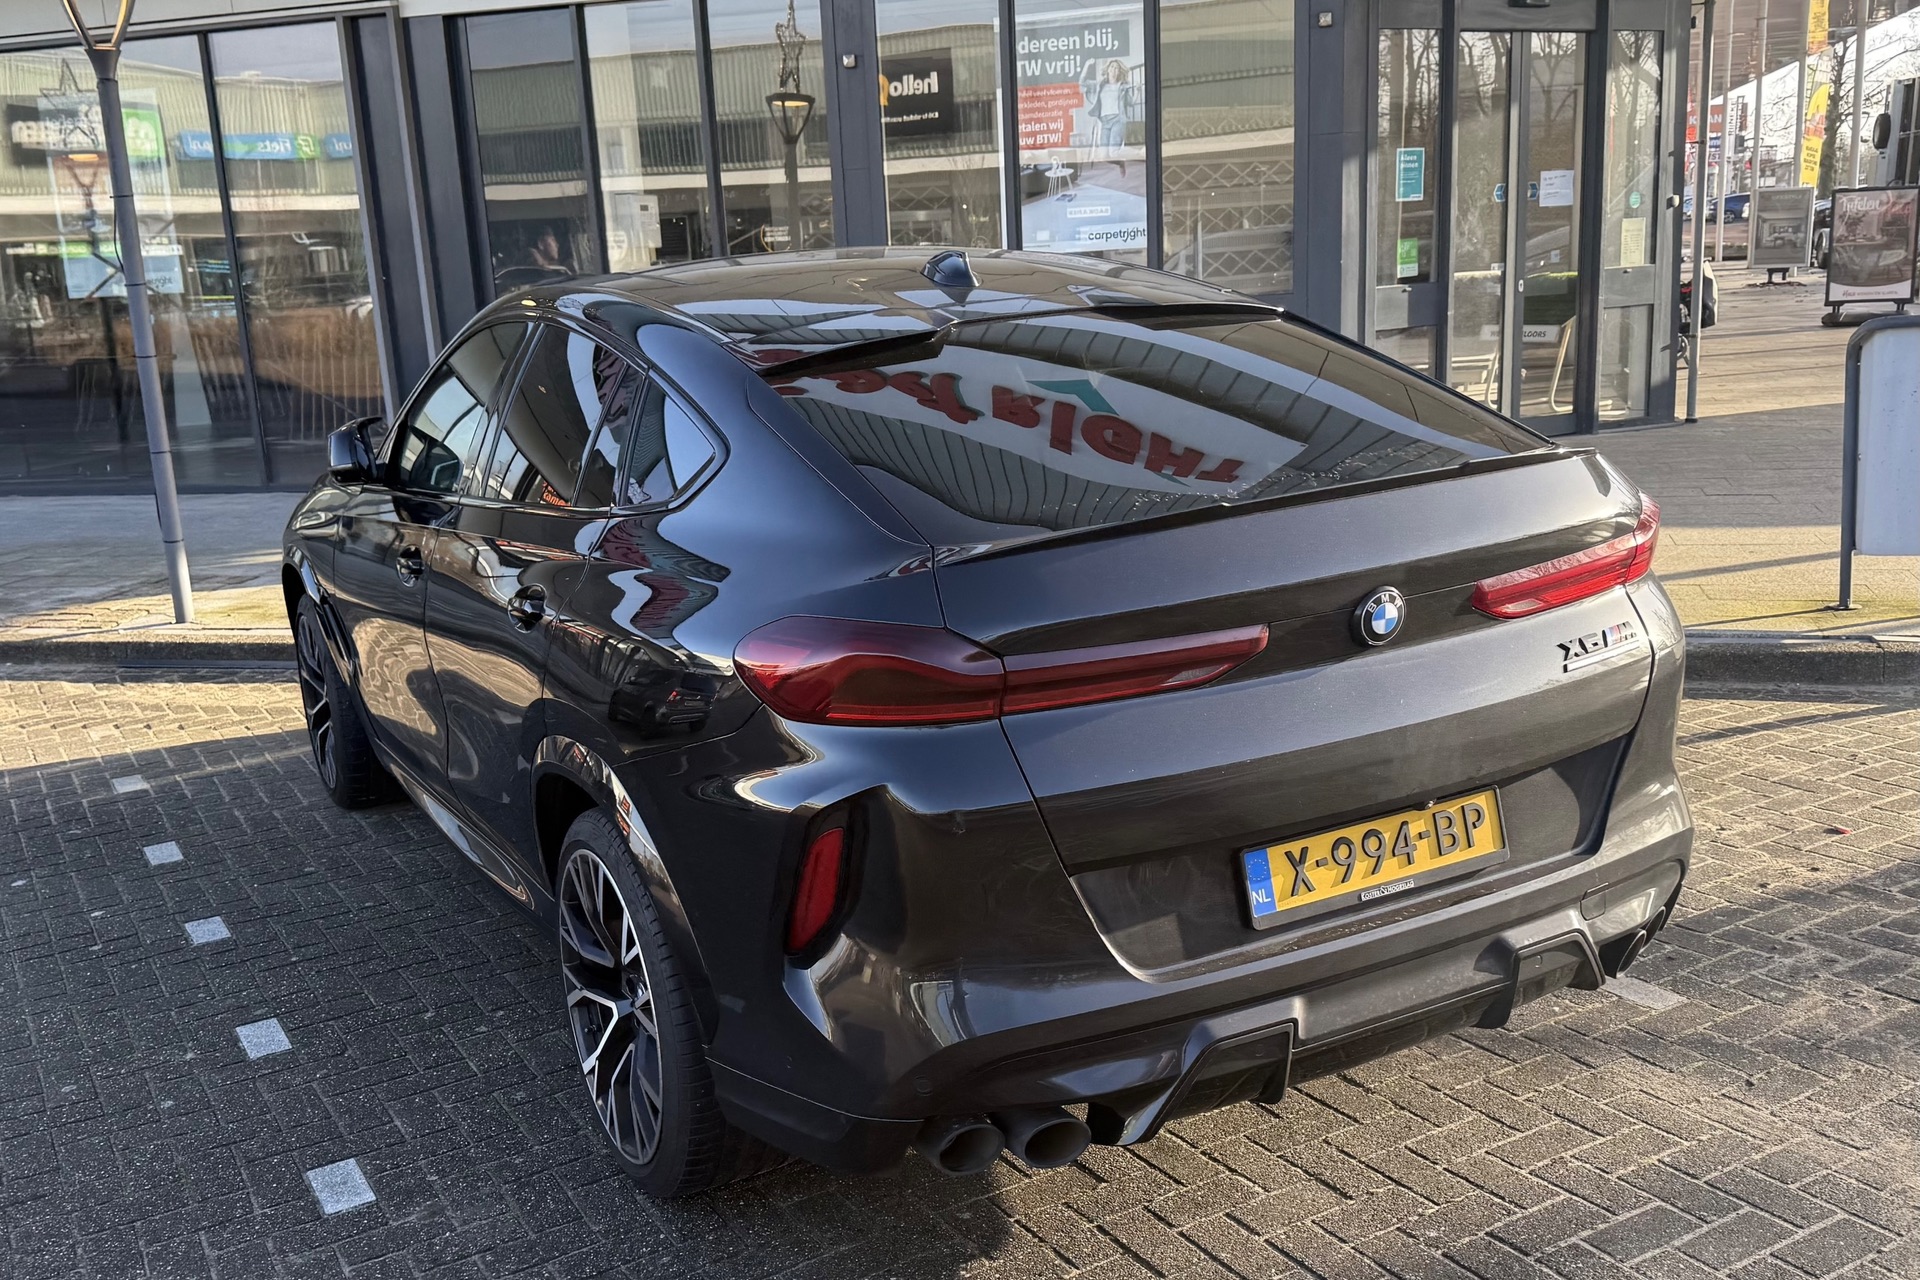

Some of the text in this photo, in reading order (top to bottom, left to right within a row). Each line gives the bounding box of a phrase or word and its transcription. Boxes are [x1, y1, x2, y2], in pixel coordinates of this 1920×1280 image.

[1084, 28, 1119, 51] blij,
[1045, 55, 1081, 77] vrij!
[1048, 119, 1064, 131] wij
[1036, 132, 1062, 144] BTW!
[1368, 592, 1403, 613] BMW
[1251, 802, 1486, 906] NL X-994-BP
